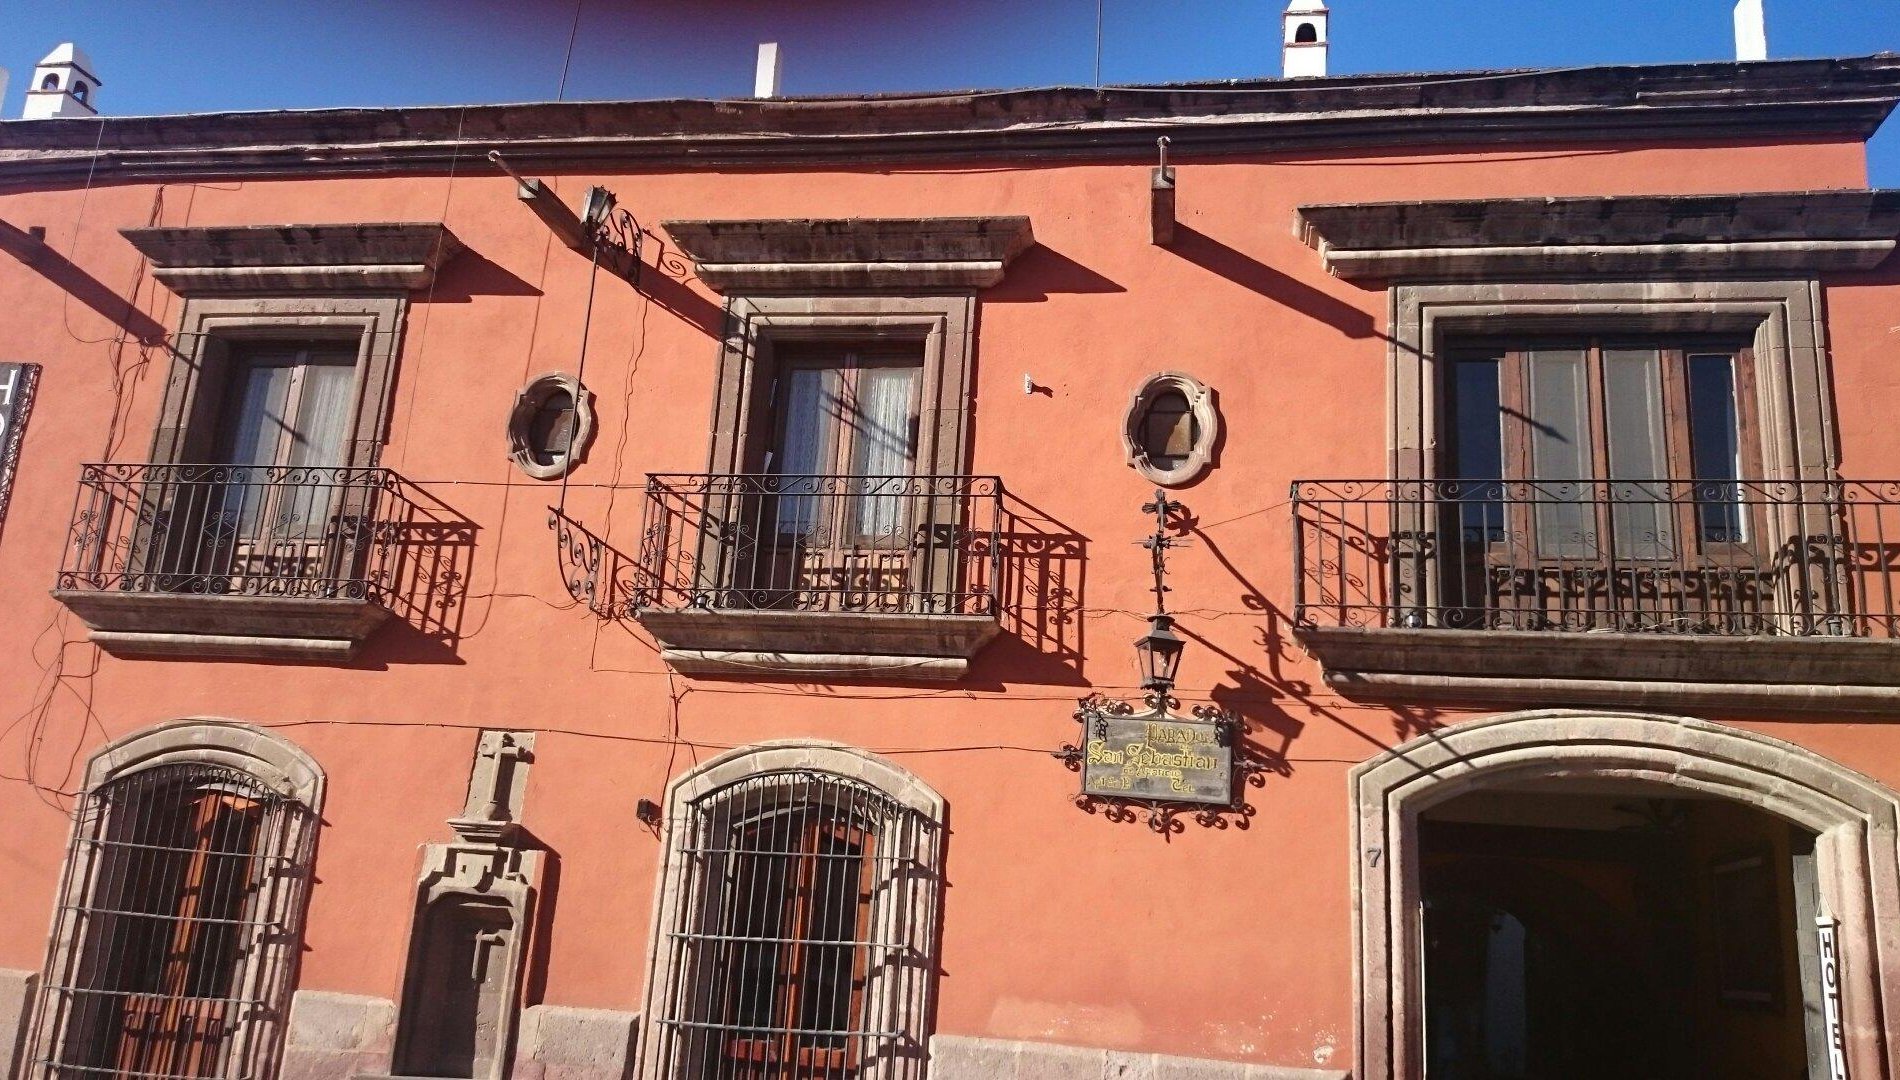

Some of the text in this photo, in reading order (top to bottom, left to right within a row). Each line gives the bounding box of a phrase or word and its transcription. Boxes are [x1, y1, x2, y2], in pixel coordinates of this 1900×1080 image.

[1087, 740, 1124, 765] San
[1367, 848, 1382, 868] 7
[1822, 932, 1843, 1080] HOTEL
